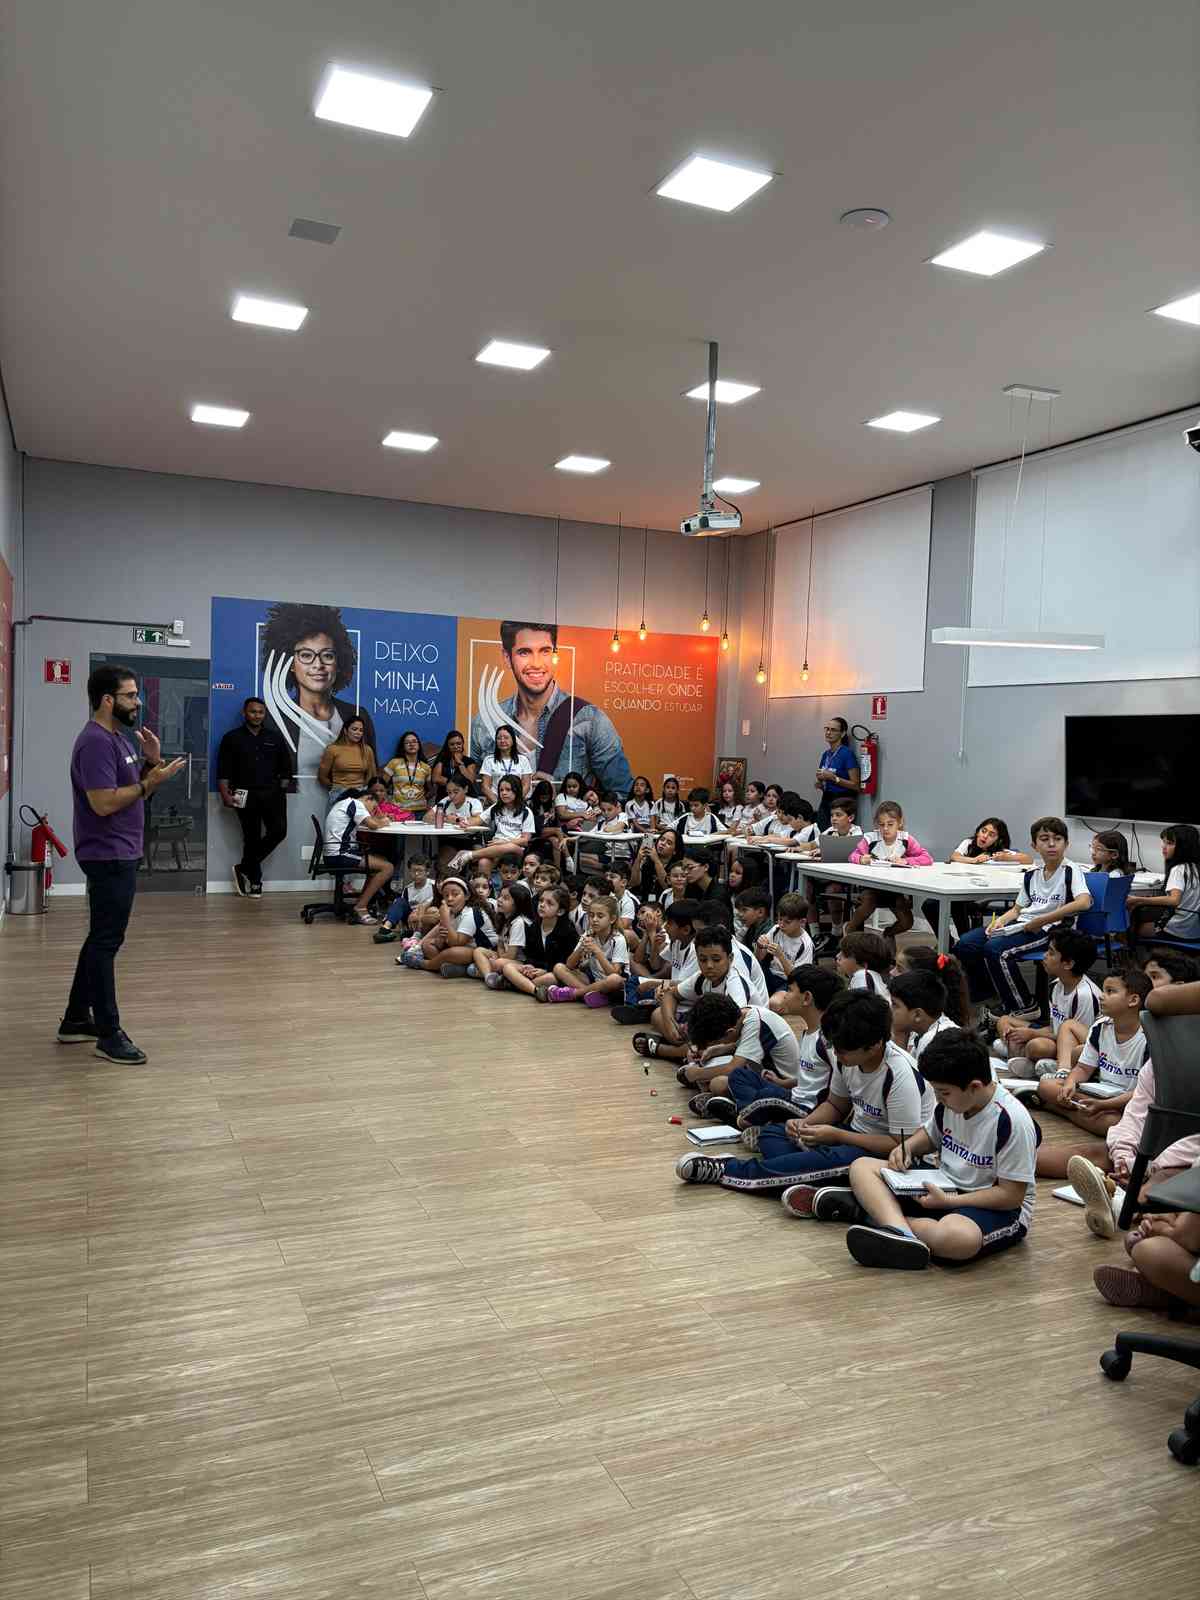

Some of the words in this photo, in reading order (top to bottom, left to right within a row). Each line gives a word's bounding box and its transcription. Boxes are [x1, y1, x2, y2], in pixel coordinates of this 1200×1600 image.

[375, 641, 439, 664] DEIXO
[604, 661, 691, 680] PRATICIDADE
[374, 670, 440, 692] MINHA
[603, 680, 664, 695] ESCOLHER
[667, 683, 704, 697] ONDE
[374, 697, 440, 717] MARCA
[612, 697, 662, 712] QUANDO
[665, 702, 703, 713] ESTUDAR
